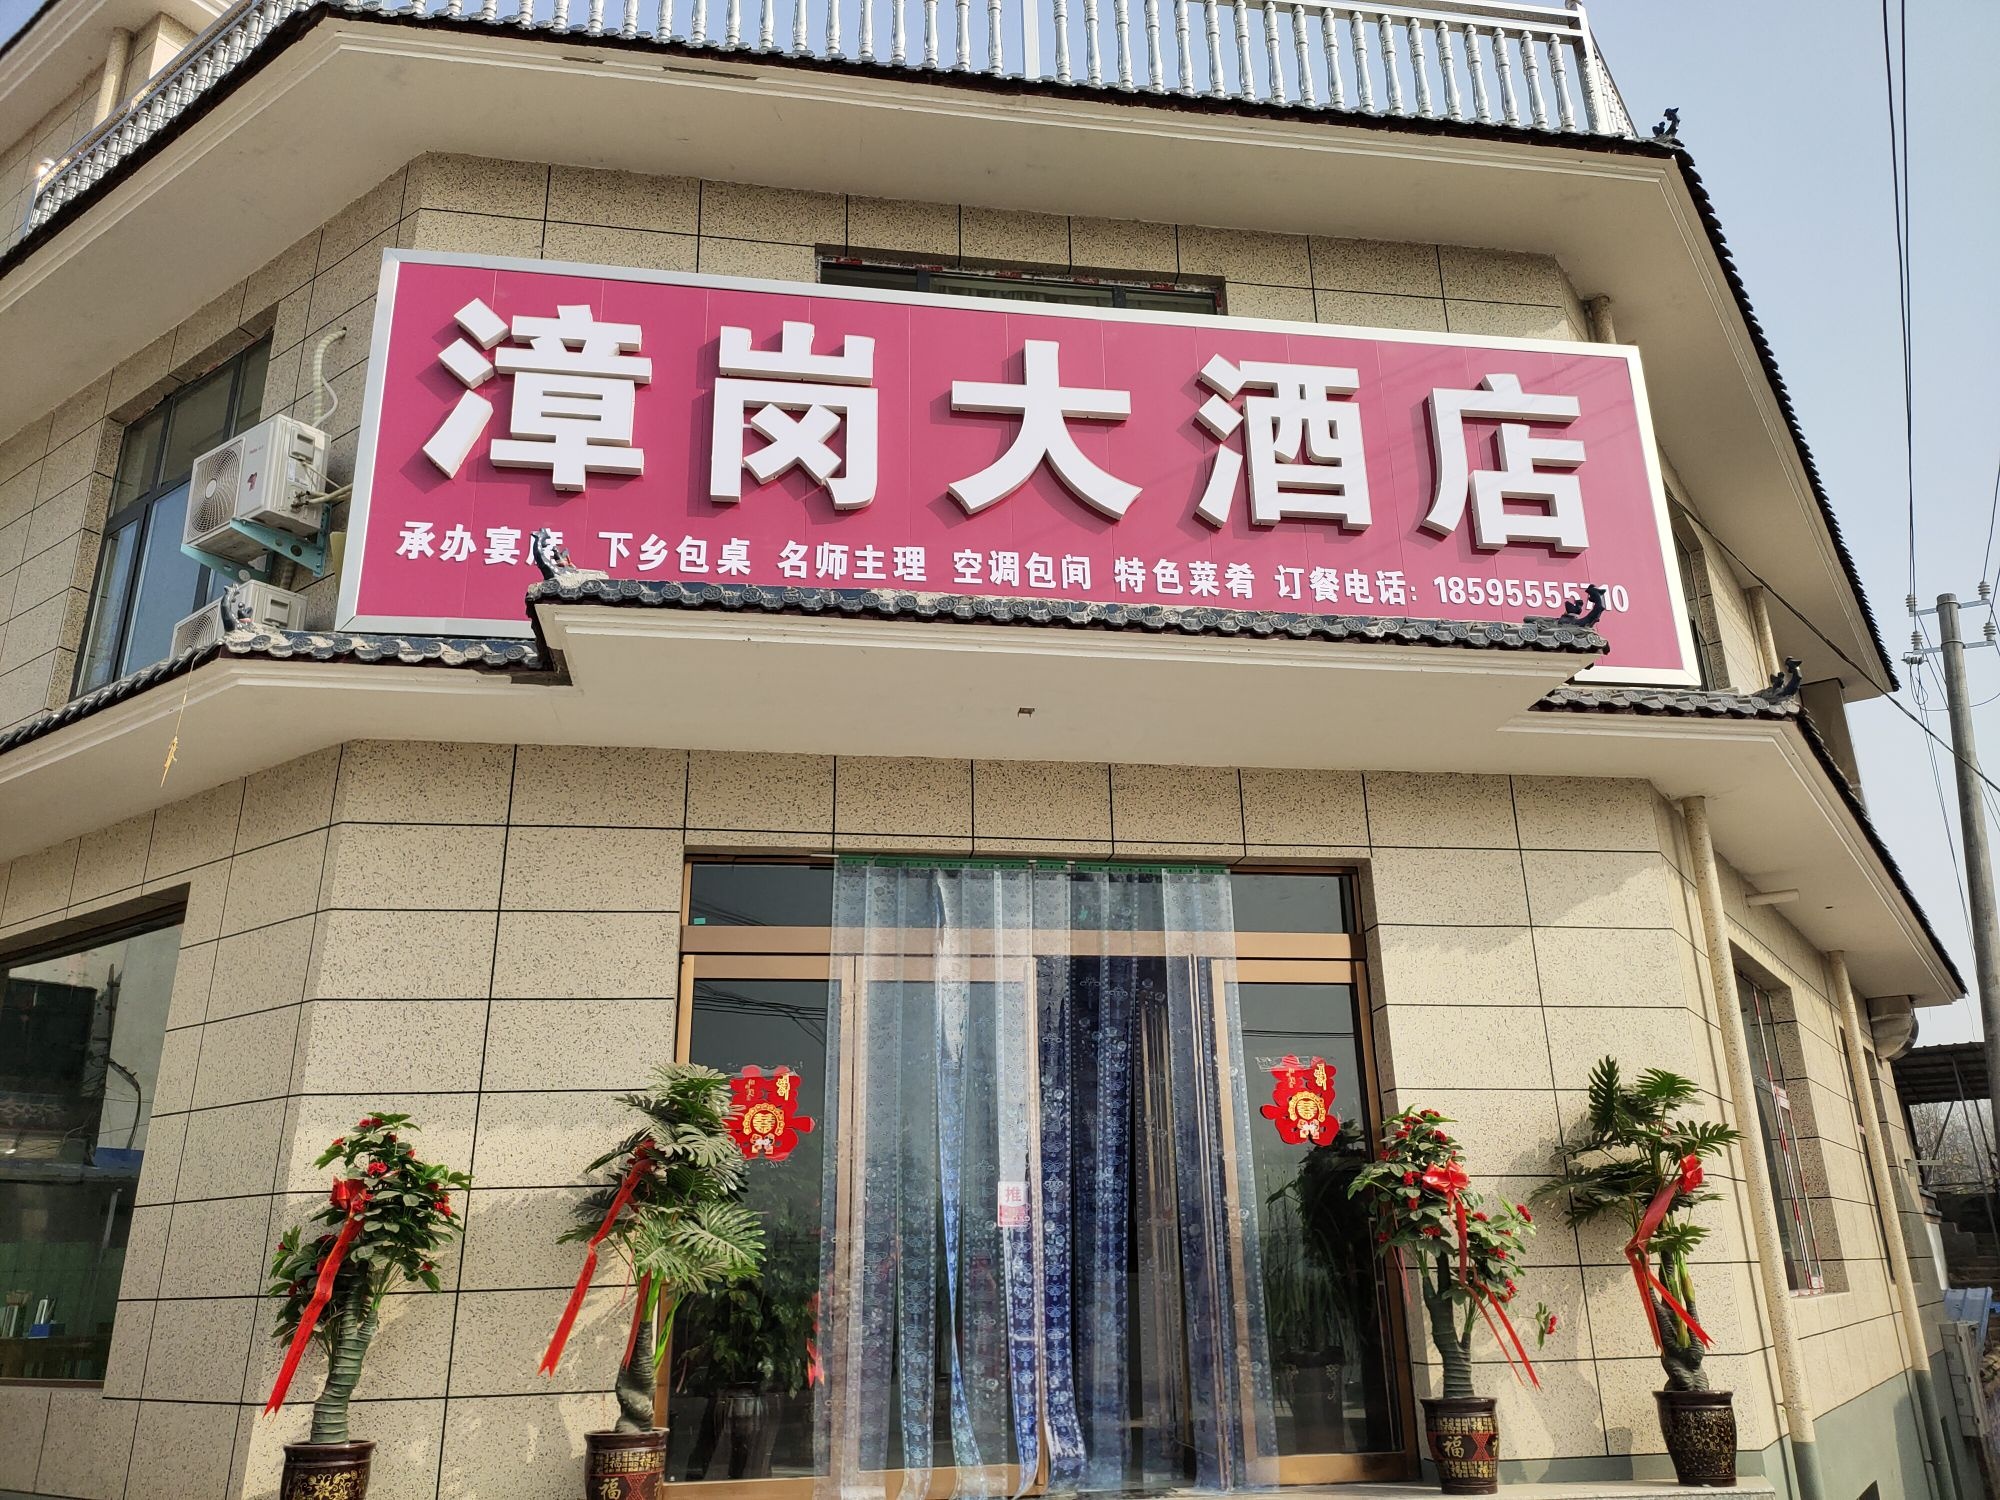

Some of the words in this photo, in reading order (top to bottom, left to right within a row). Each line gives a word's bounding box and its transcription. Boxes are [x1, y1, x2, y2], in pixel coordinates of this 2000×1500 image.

[422, 297, 1589, 553] 漳岗大酒店
[598, 531, 752, 576] 下乡包桌
[777, 540, 927, 582] 名师主理
[952, 548, 1092, 590] 空调包间
[1113, 556, 1256, 599] 特色菜肴
[1006, 1186, 1021, 1202] 推
[1442, 1435, 1465, 1458] 福
[598, 1477, 622, 1500] 福
